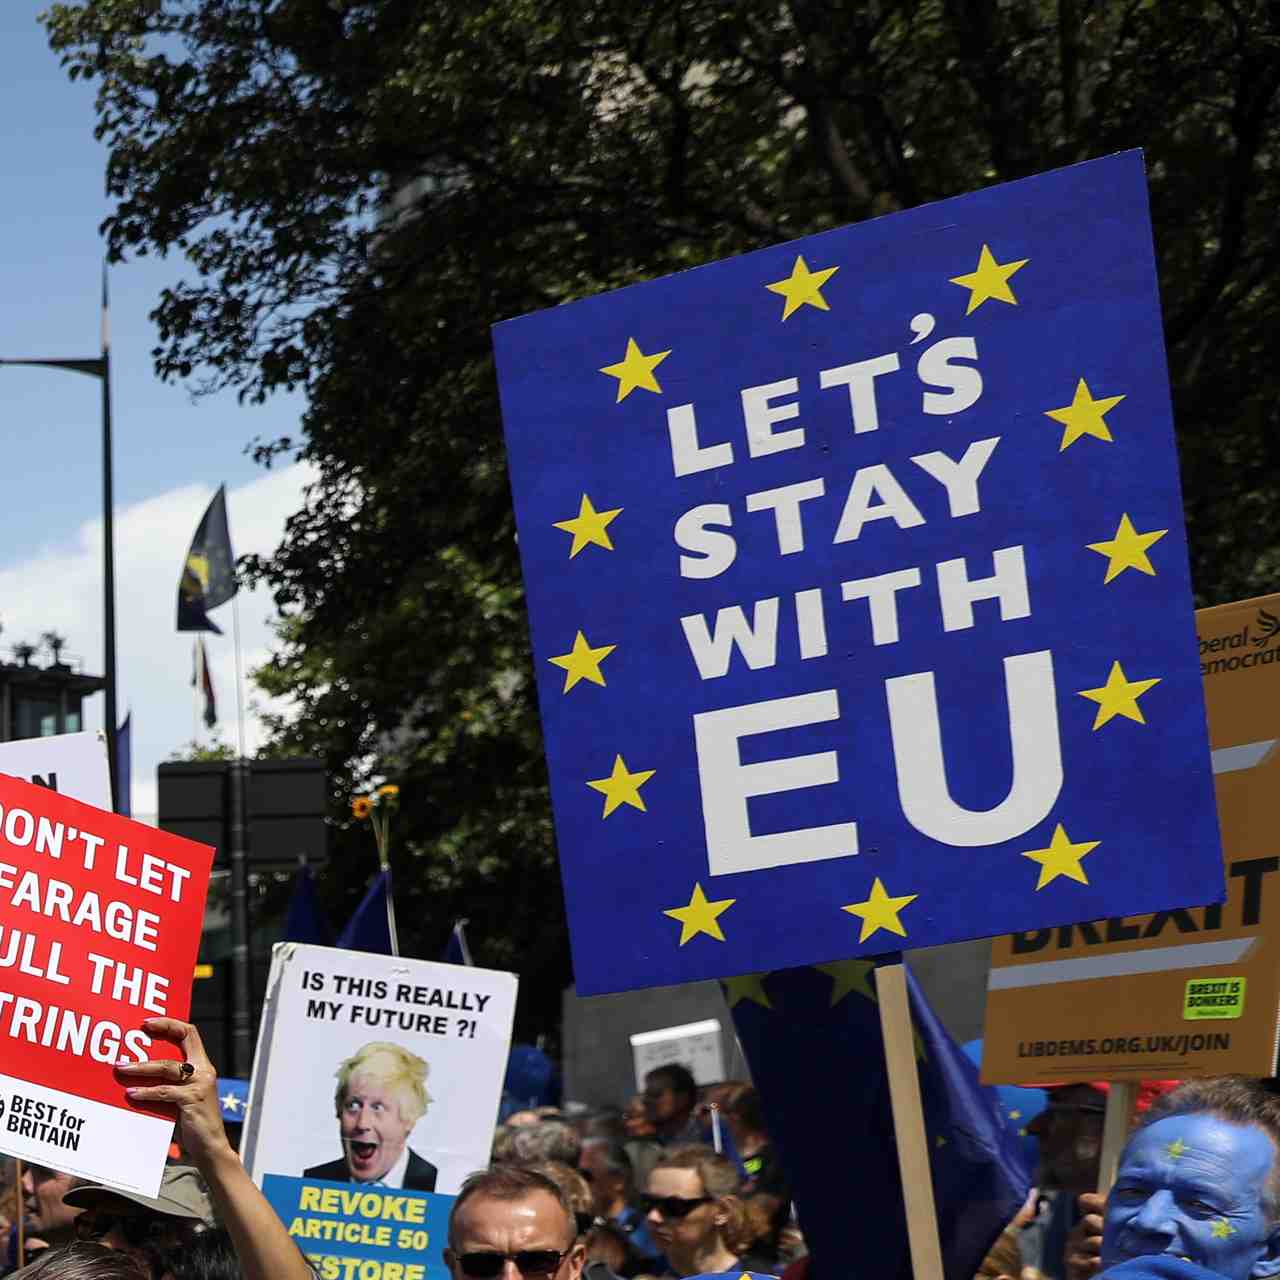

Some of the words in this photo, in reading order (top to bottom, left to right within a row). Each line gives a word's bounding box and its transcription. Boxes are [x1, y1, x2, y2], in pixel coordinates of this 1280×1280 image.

[665, 312, 983, 478] LET'S
[673, 436, 1001, 580] STAY
[680, 545, 1032, 681] WITH
[1196, 624, 1248, 655] beral
[693, 650, 1065, 877] EU
[115, 844, 192, 903] LET
[87, 952, 170, 1016] THE
[301, 971, 324, 991] IS
[333, 975, 388, 999] THIS
[396, 984, 491, 1013] REALLY
[306, 999, 343, 1022] MY
[350, 1005, 448, 1035] FUTURE
[457, 1020, 477, 1039] ?!
[1018, 1033, 1230, 1058] LIBDEMS.ORG.UK/JOIN
[6, 1114, 81, 1152] BRITAIN
[10, 1095, 58, 1123] BEST
[60, 1107, 86, 1132] for
[298, 1186, 428, 1223] REVOKE
[288, 1217, 392, 1248] ARTICLE
[397, 1229, 429, 1250] 50
